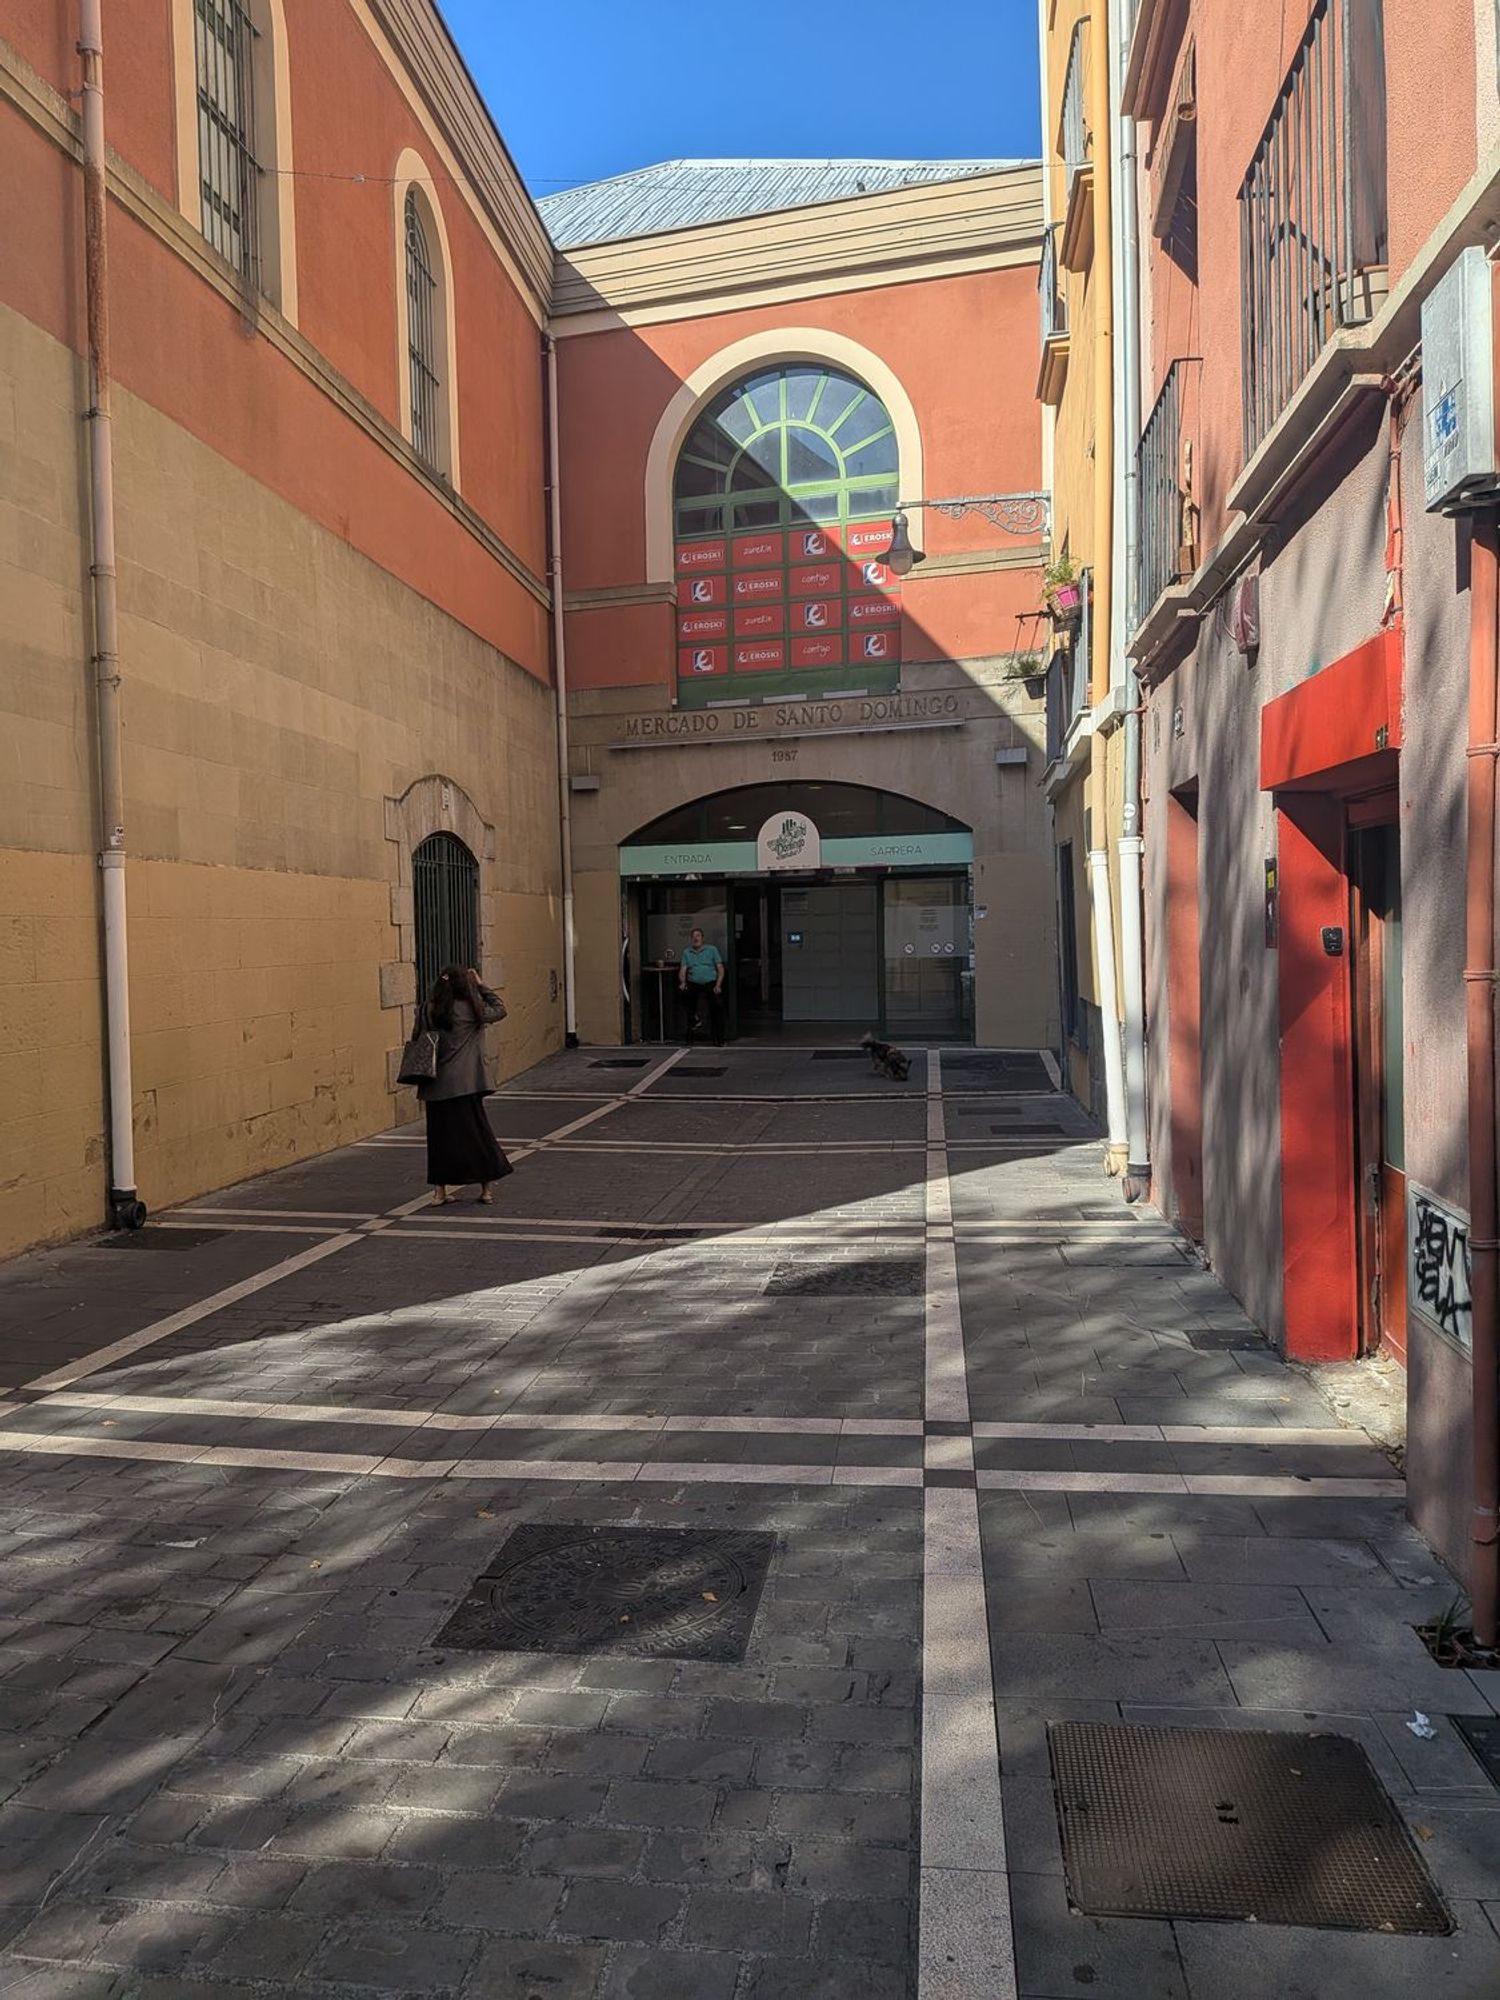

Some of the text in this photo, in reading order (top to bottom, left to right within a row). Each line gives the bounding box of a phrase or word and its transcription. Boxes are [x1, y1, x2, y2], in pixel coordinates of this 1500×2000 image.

[864, 532, 893, 542] EROSK
[692, 551, 721, 561] EROSKI
[801, 571, 830, 586] contigo
[749, 580, 779, 590] EROSKI
[865, 605, 896, 614] EROSKI
[693, 621, 723, 630] EROSKI
[802, 642, 831, 657] contigo
[750, 651, 780, 660] EROSKI
[626, 694, 958, 737] MERCADO DE SANTO DOMINGO
[870, 845, 922, 856] SARRERA
[663, 853, 712, 864] ENTRADA
